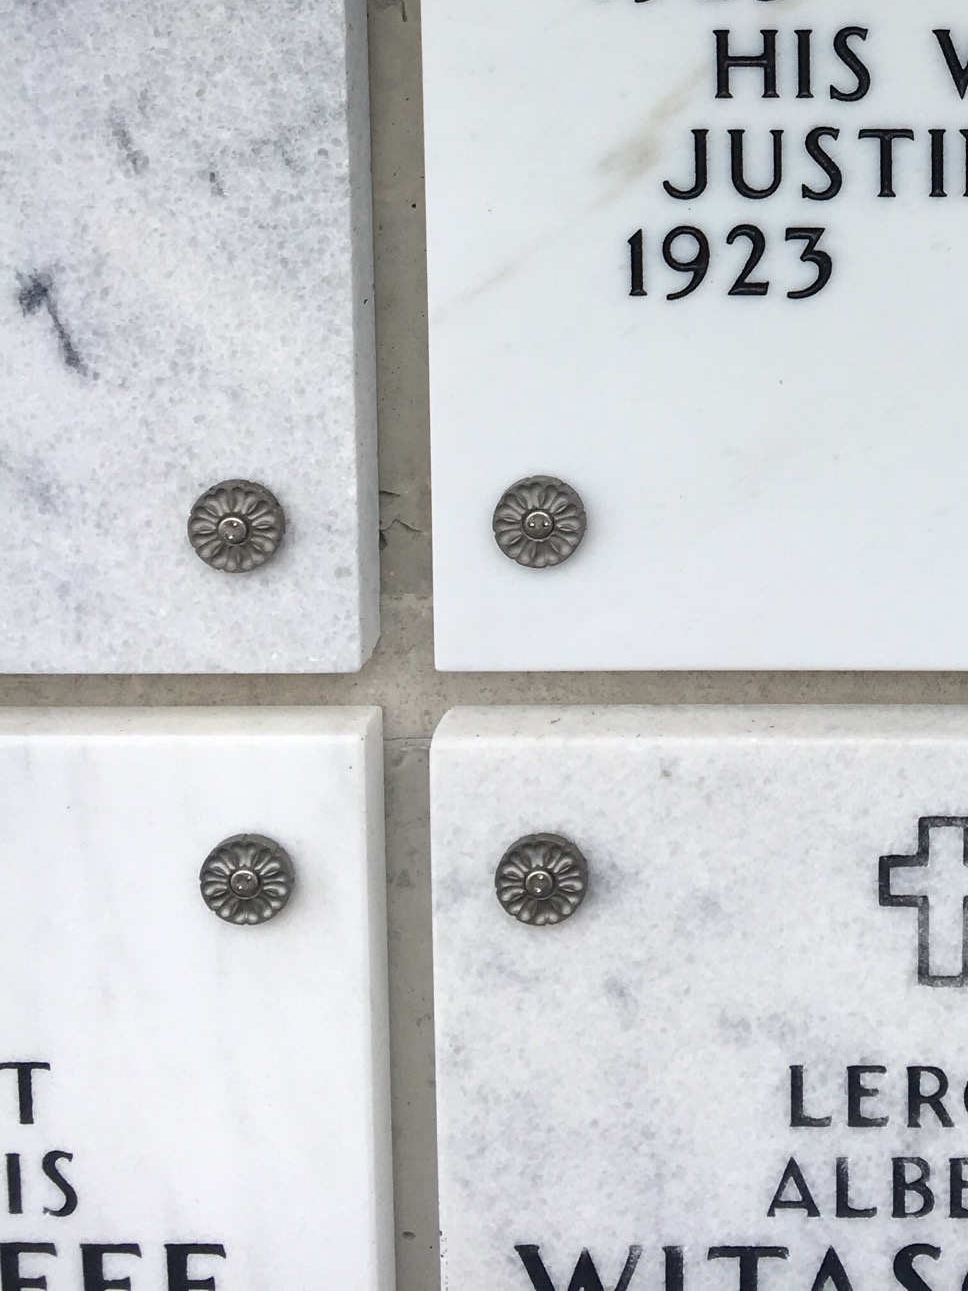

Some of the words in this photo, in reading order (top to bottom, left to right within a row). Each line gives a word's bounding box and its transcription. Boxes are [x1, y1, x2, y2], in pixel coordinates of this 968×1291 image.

[712, 26, 871, 103] HIS
[627, 223, 833, 301] 1923
[0, 1061, 51, 1125] T
[5, 1150, 78, 1217] IS
